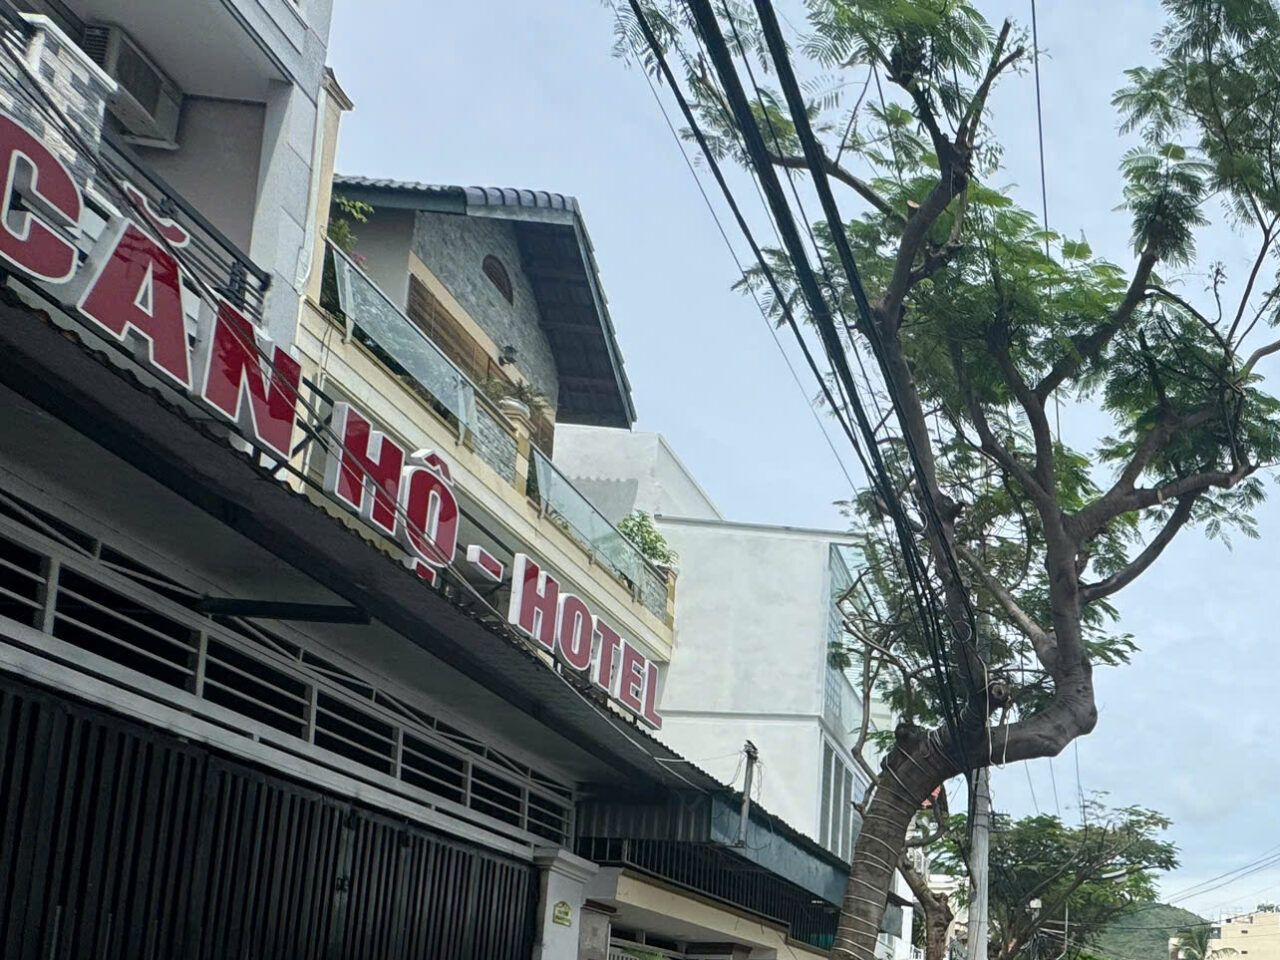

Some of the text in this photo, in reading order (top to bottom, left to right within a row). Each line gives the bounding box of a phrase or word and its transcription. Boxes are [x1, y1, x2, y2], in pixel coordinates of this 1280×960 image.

[0, 112, 303, 461] CĂN
[328, 402, 461, 587] HỘ
[510, 553, 663, 730] HOTEL
